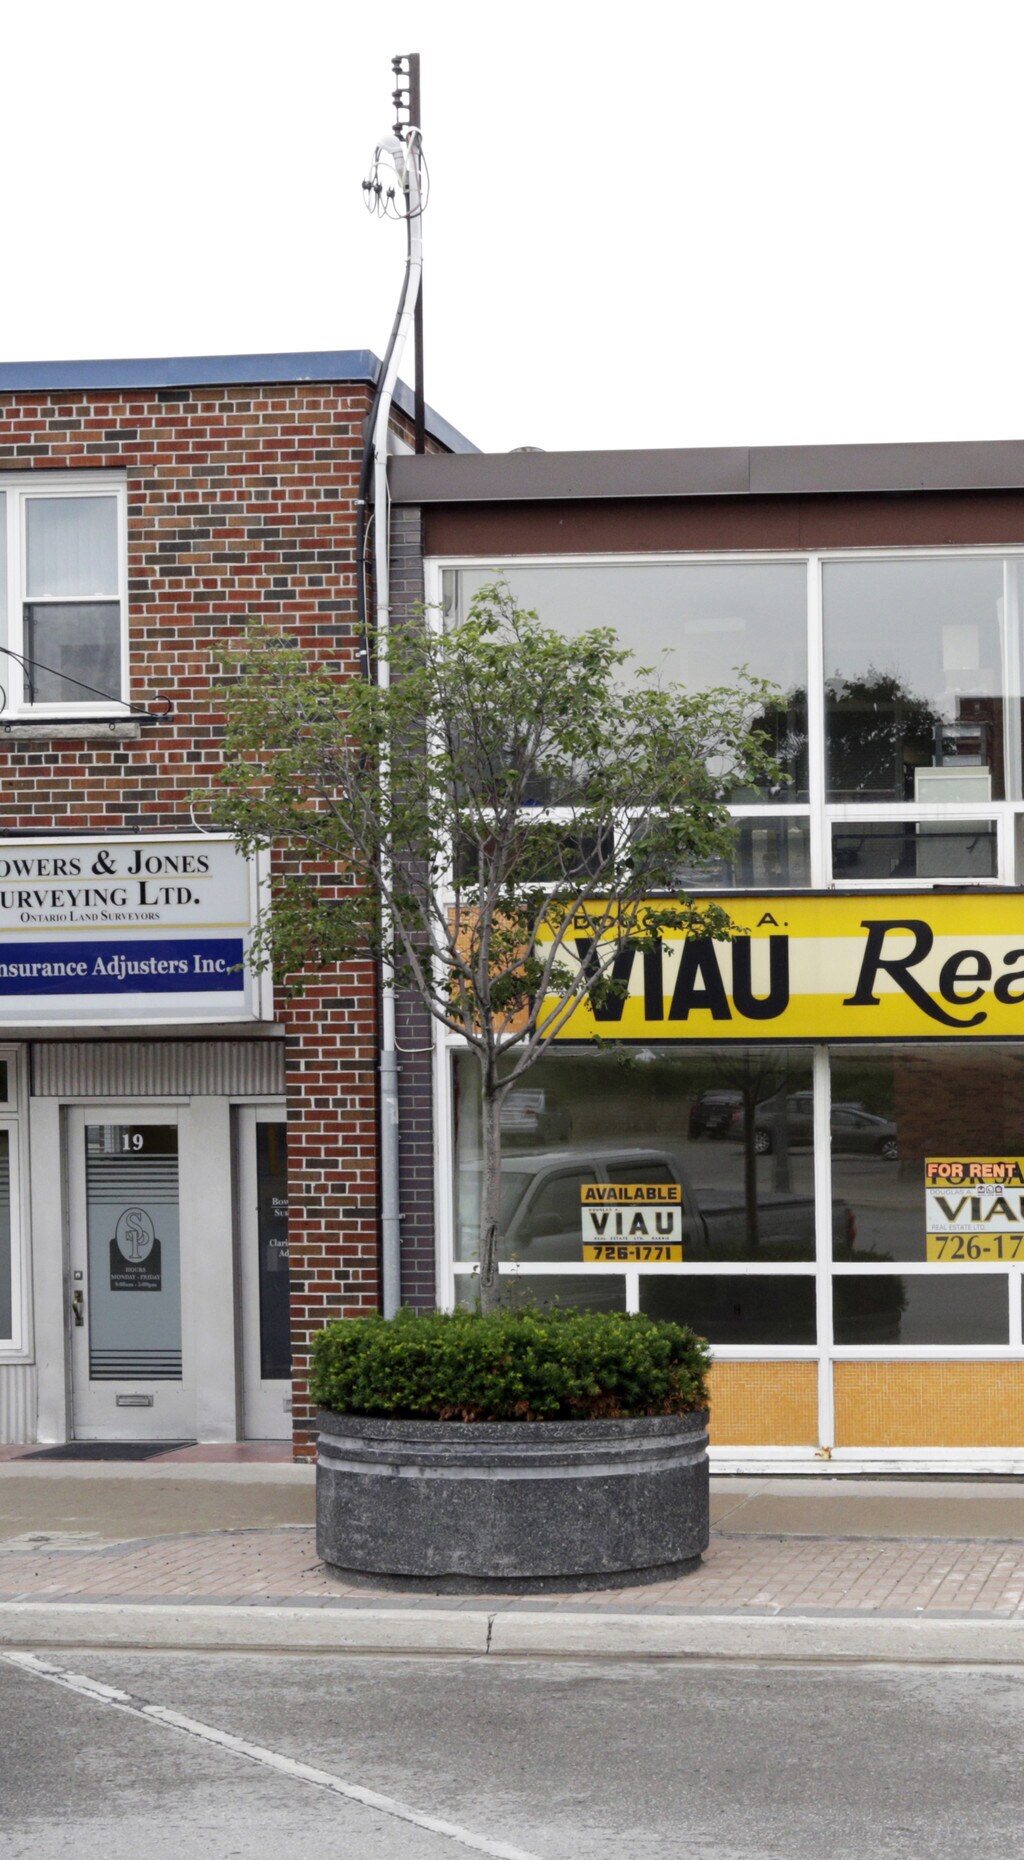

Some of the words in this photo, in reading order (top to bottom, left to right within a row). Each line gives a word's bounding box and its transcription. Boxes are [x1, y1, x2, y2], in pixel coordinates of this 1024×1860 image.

[91, 849, 118, 875] &
[127, 849, 209, 875] JONES
[0, 887, 127, 908] URVEYING
[137, 880, 200, 906] LTD.
[20, 912, 67, 923] ONTARIO
[69, 911, 98, 922] LAND
[101, 910, 160, 921] SURVEYORS
[757, 912, 788, 927] A.
[92, 955, 188, 980] Adjusters
[575, 934, 790, 1021] VIAU
[122, 1133, 144, 1150] 19
[928, 1163, 963, 1178] FOR
[969, 1163, 1016, 1178] RENT
[585, 1187, 678, 1200] AVAILABLE
[589, 1212, 675, 1236] VIAU
[593, 1246, 672, 1260] 726-1771
